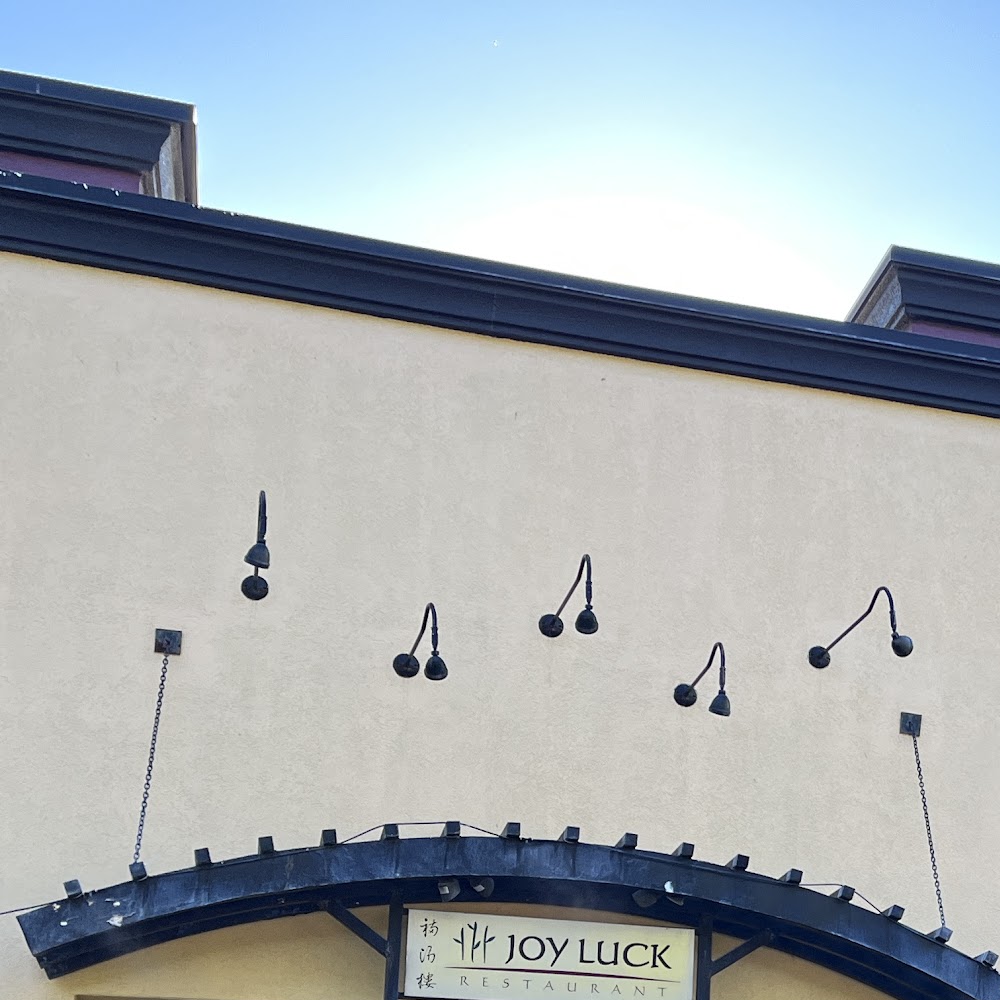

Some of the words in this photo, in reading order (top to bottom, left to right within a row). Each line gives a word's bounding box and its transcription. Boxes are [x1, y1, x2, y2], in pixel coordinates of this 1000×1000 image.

[505, 934, 569, 967] JOY
[579, 938, 672, 970] LUCK
[460, 975, 668, 998] RESTAURANT
